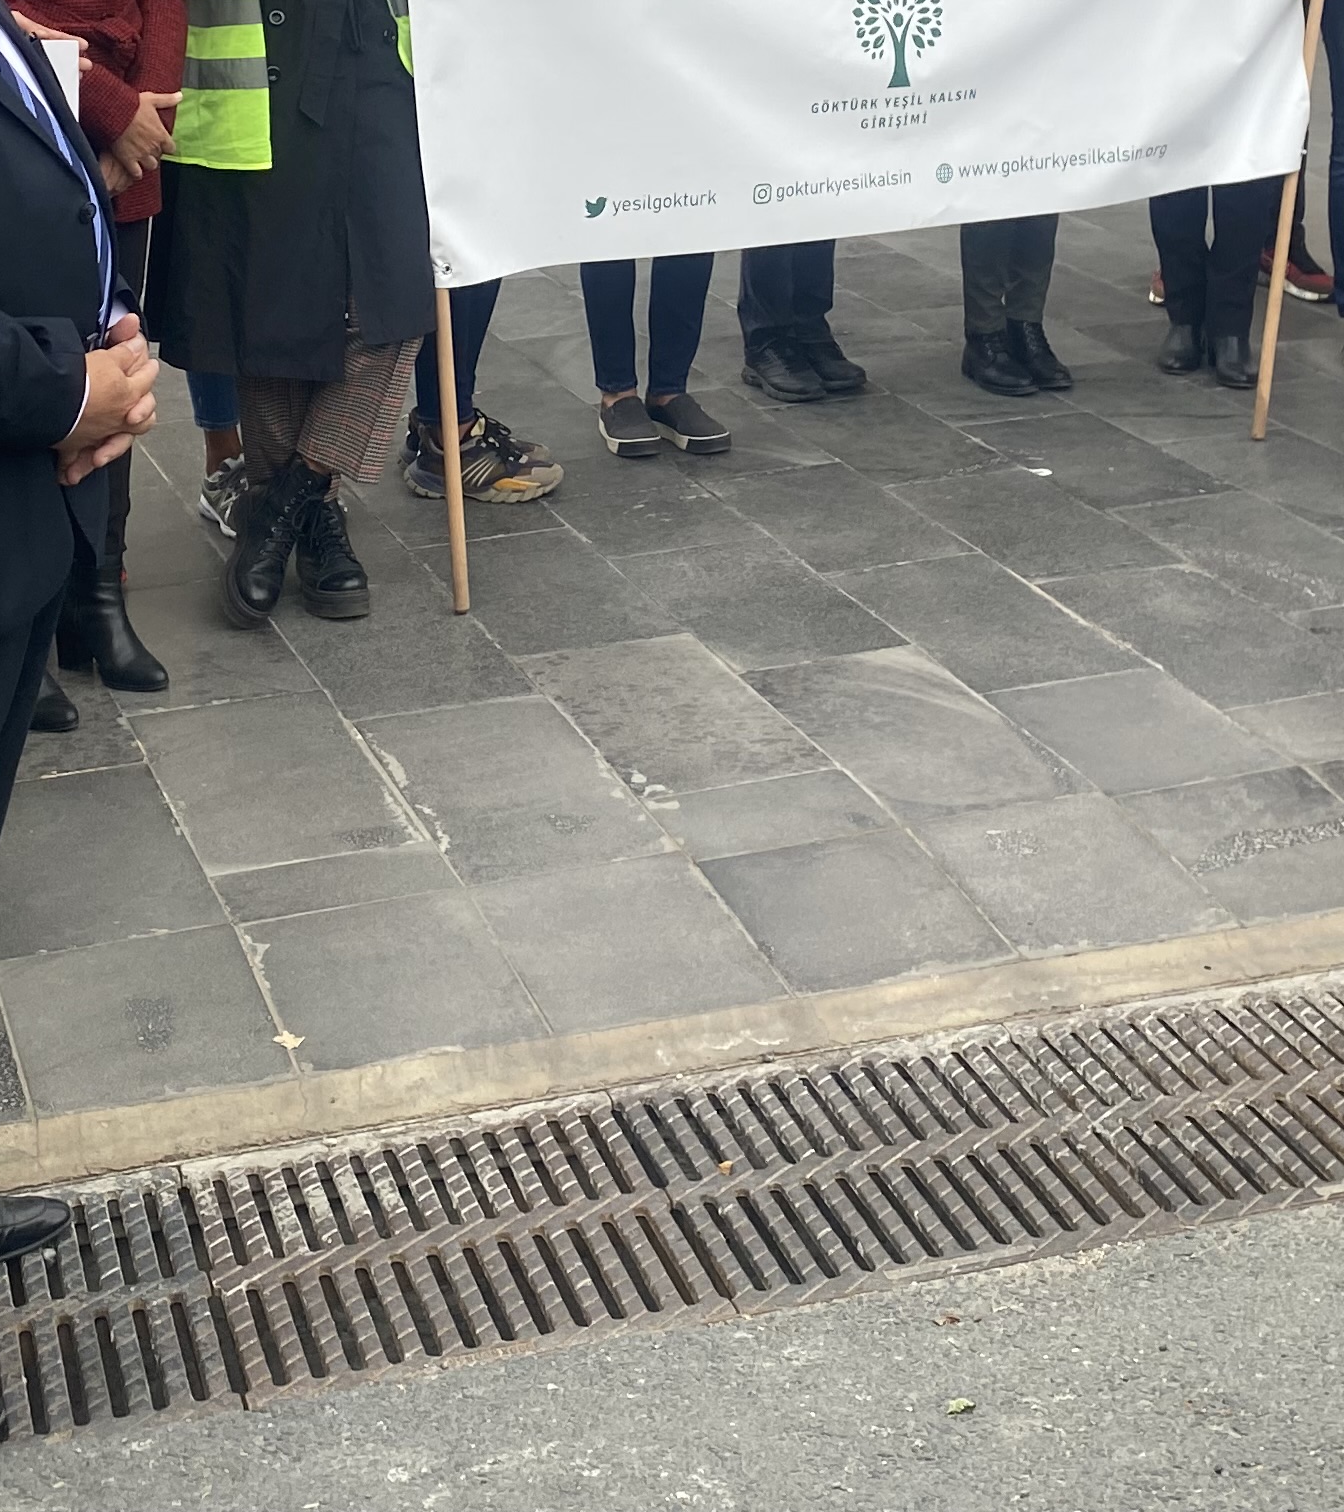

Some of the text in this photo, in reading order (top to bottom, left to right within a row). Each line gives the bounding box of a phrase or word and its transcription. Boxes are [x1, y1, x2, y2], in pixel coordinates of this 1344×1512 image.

[811, 88, 978, 114] GÖKTÜRK YEŞİL KALSIN
[860, 110, 928, 129] GİRİŞİMİ
[959, 143, 1168, 178] www.gokturkyesilkalsin.org
[776, 169, 912, 202] gokturkyesilkalsin
[612, 190, 717, 217] yesilgokturk
